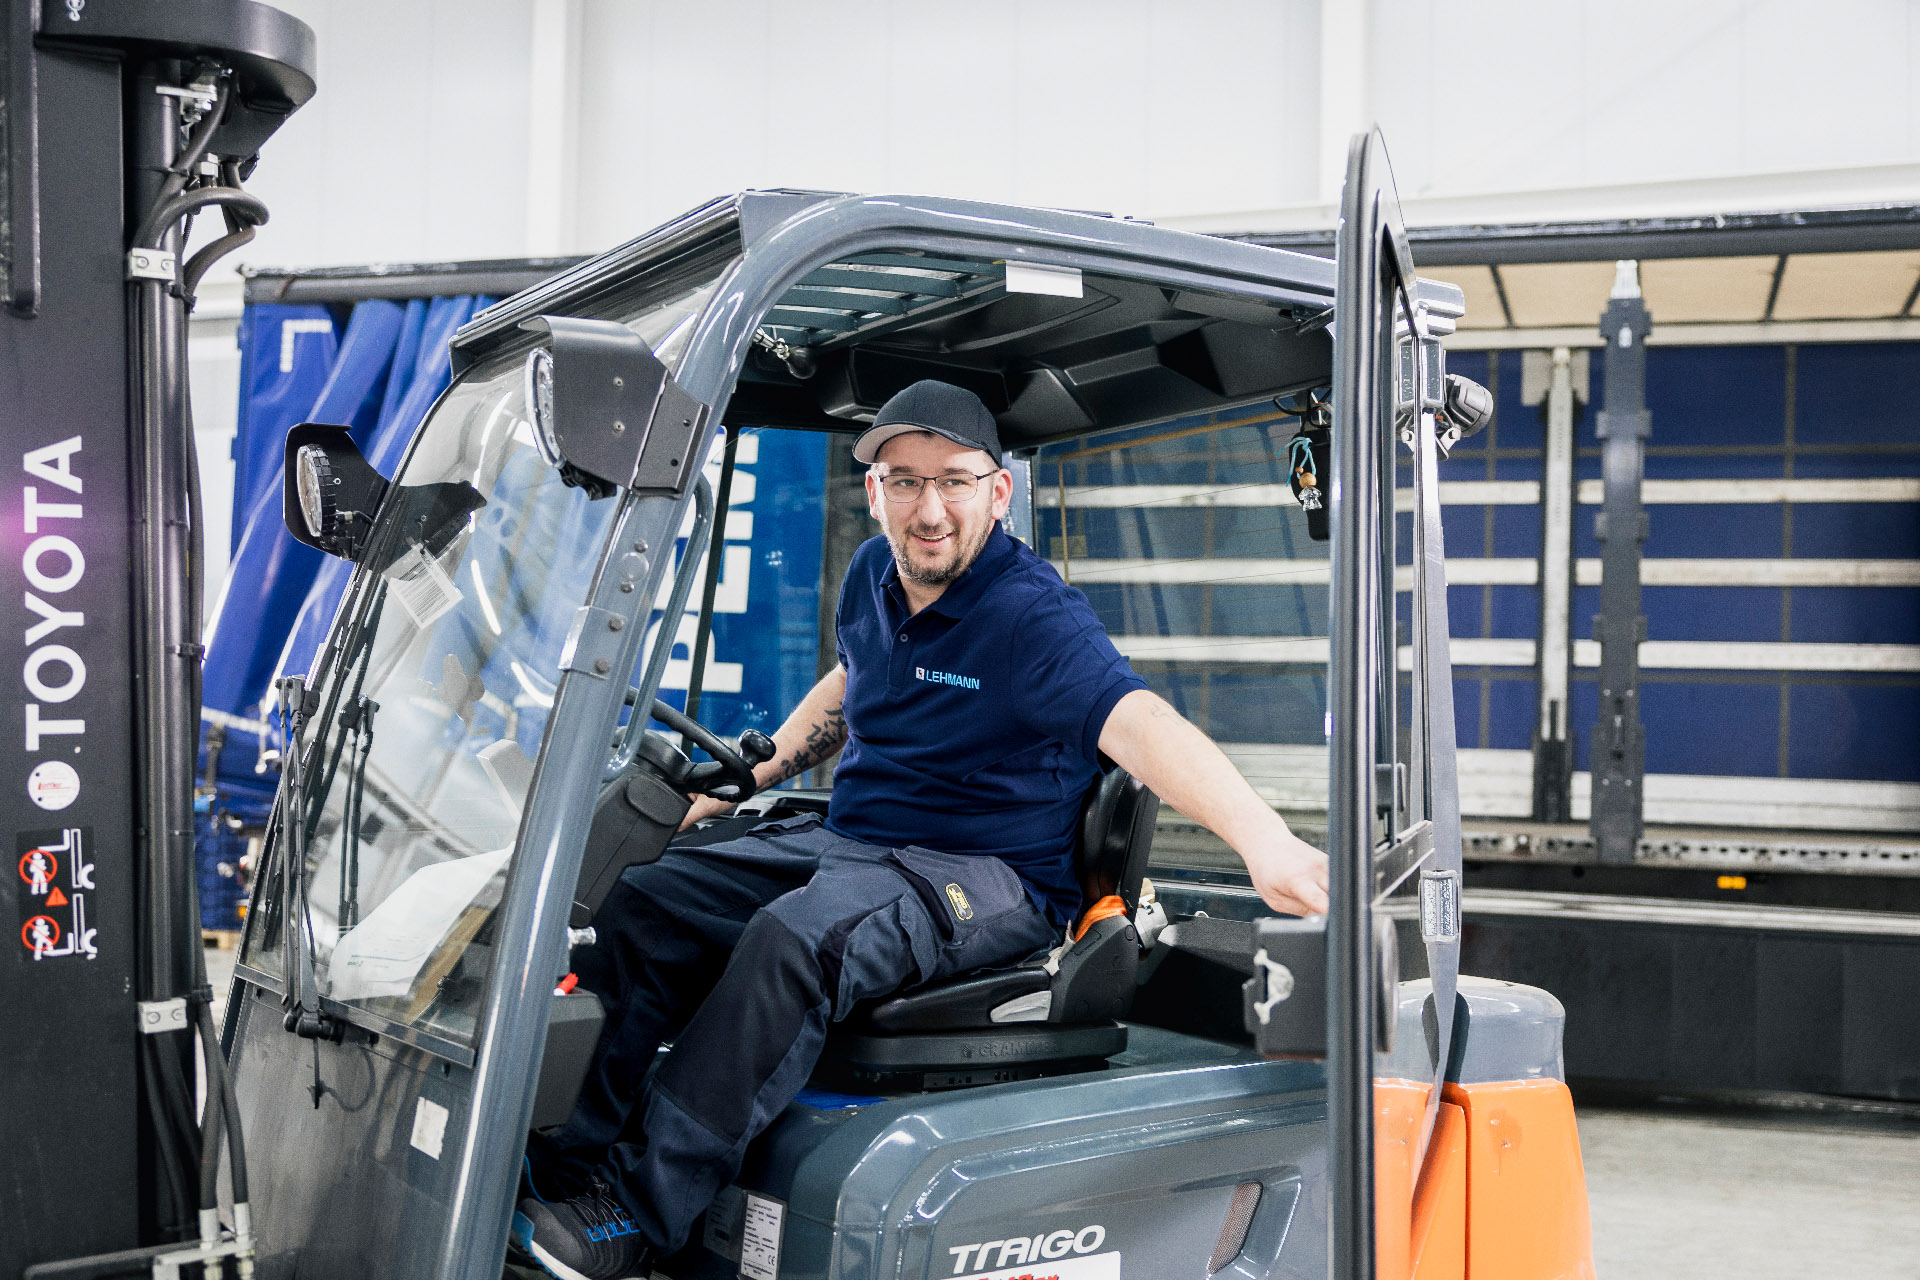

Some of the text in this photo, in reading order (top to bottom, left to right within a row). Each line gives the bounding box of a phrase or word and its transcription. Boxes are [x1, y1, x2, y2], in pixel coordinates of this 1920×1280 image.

[22, 435, 87, 752] TOYOTA
[926, 669, 980, 690] LEHMANN
[949, 1224, 1106, 1274] TRAIGO
